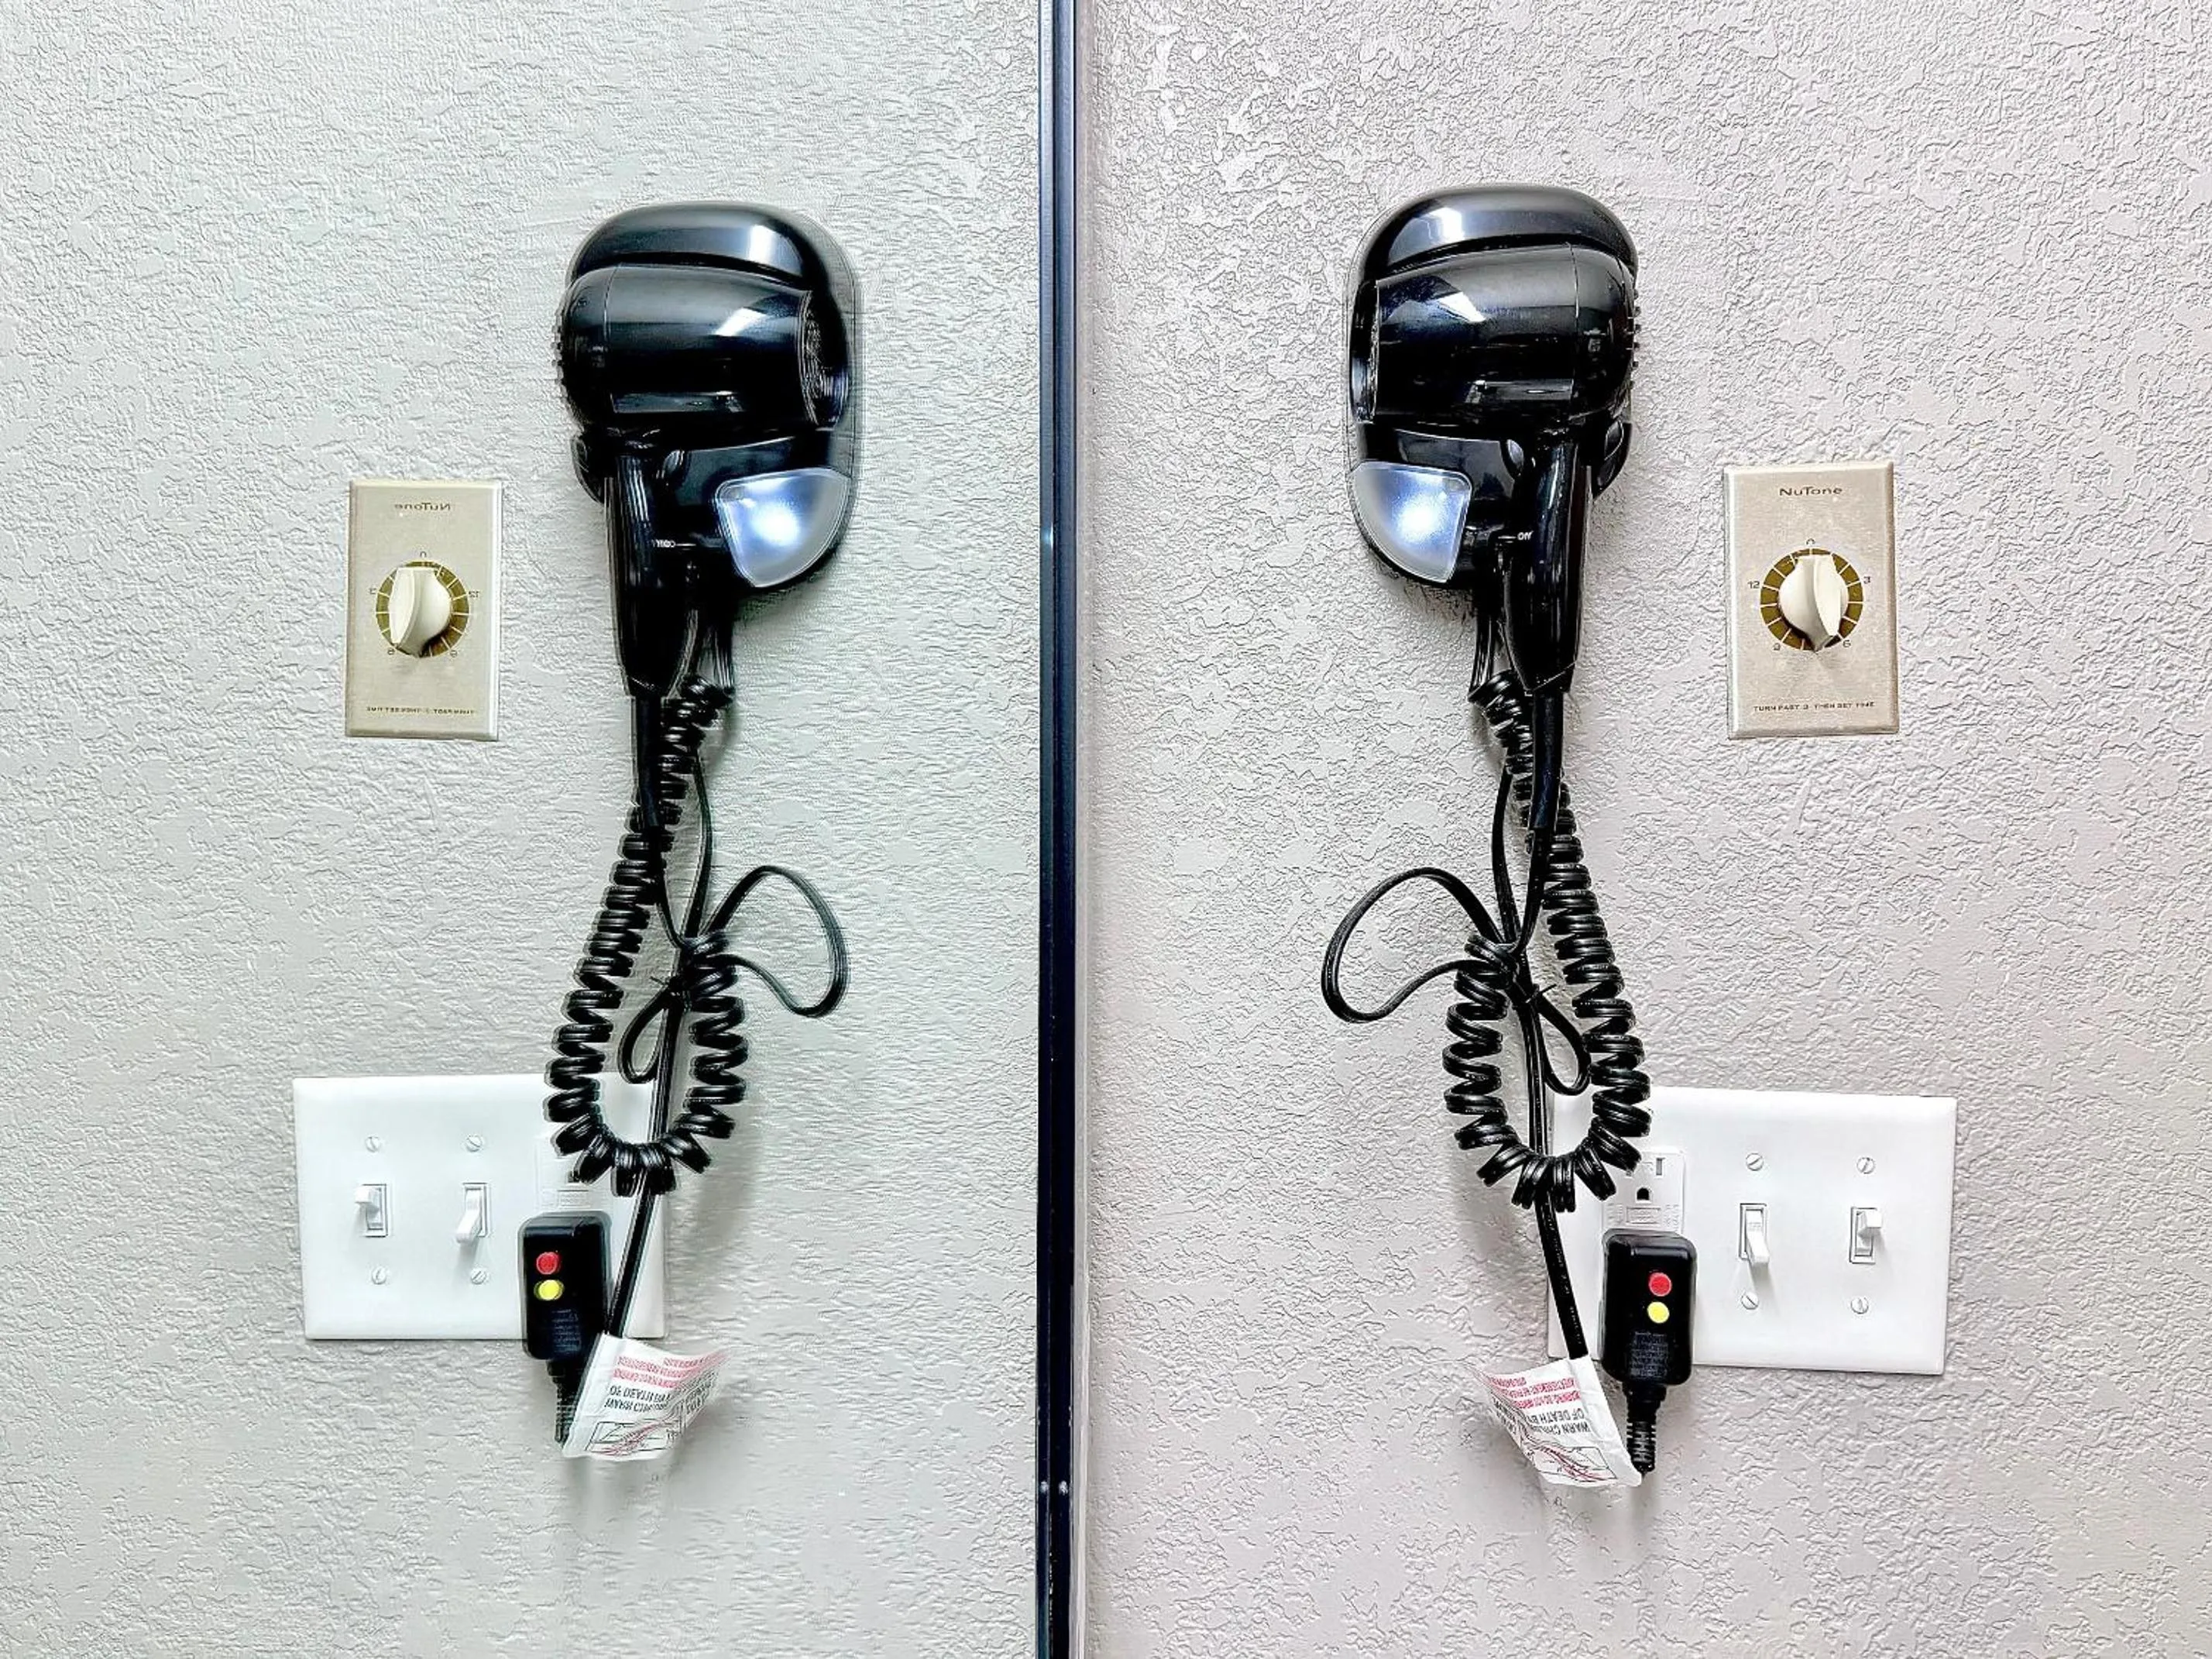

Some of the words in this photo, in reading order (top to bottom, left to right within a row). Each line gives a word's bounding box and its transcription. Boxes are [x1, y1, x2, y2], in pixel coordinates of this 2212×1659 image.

[1779, 486, 1843, 496] NuTone
[1748, 580, 1760, 589] 12
[1863, 575, 1871, 585] 3
[1843, 639, 1851, 648] 6
[1540, 1409, 1571, 1423] DEATH
[1572, 1407, 1585, 1420] OF
[1560, 1421, 1591, 1435] WARN
